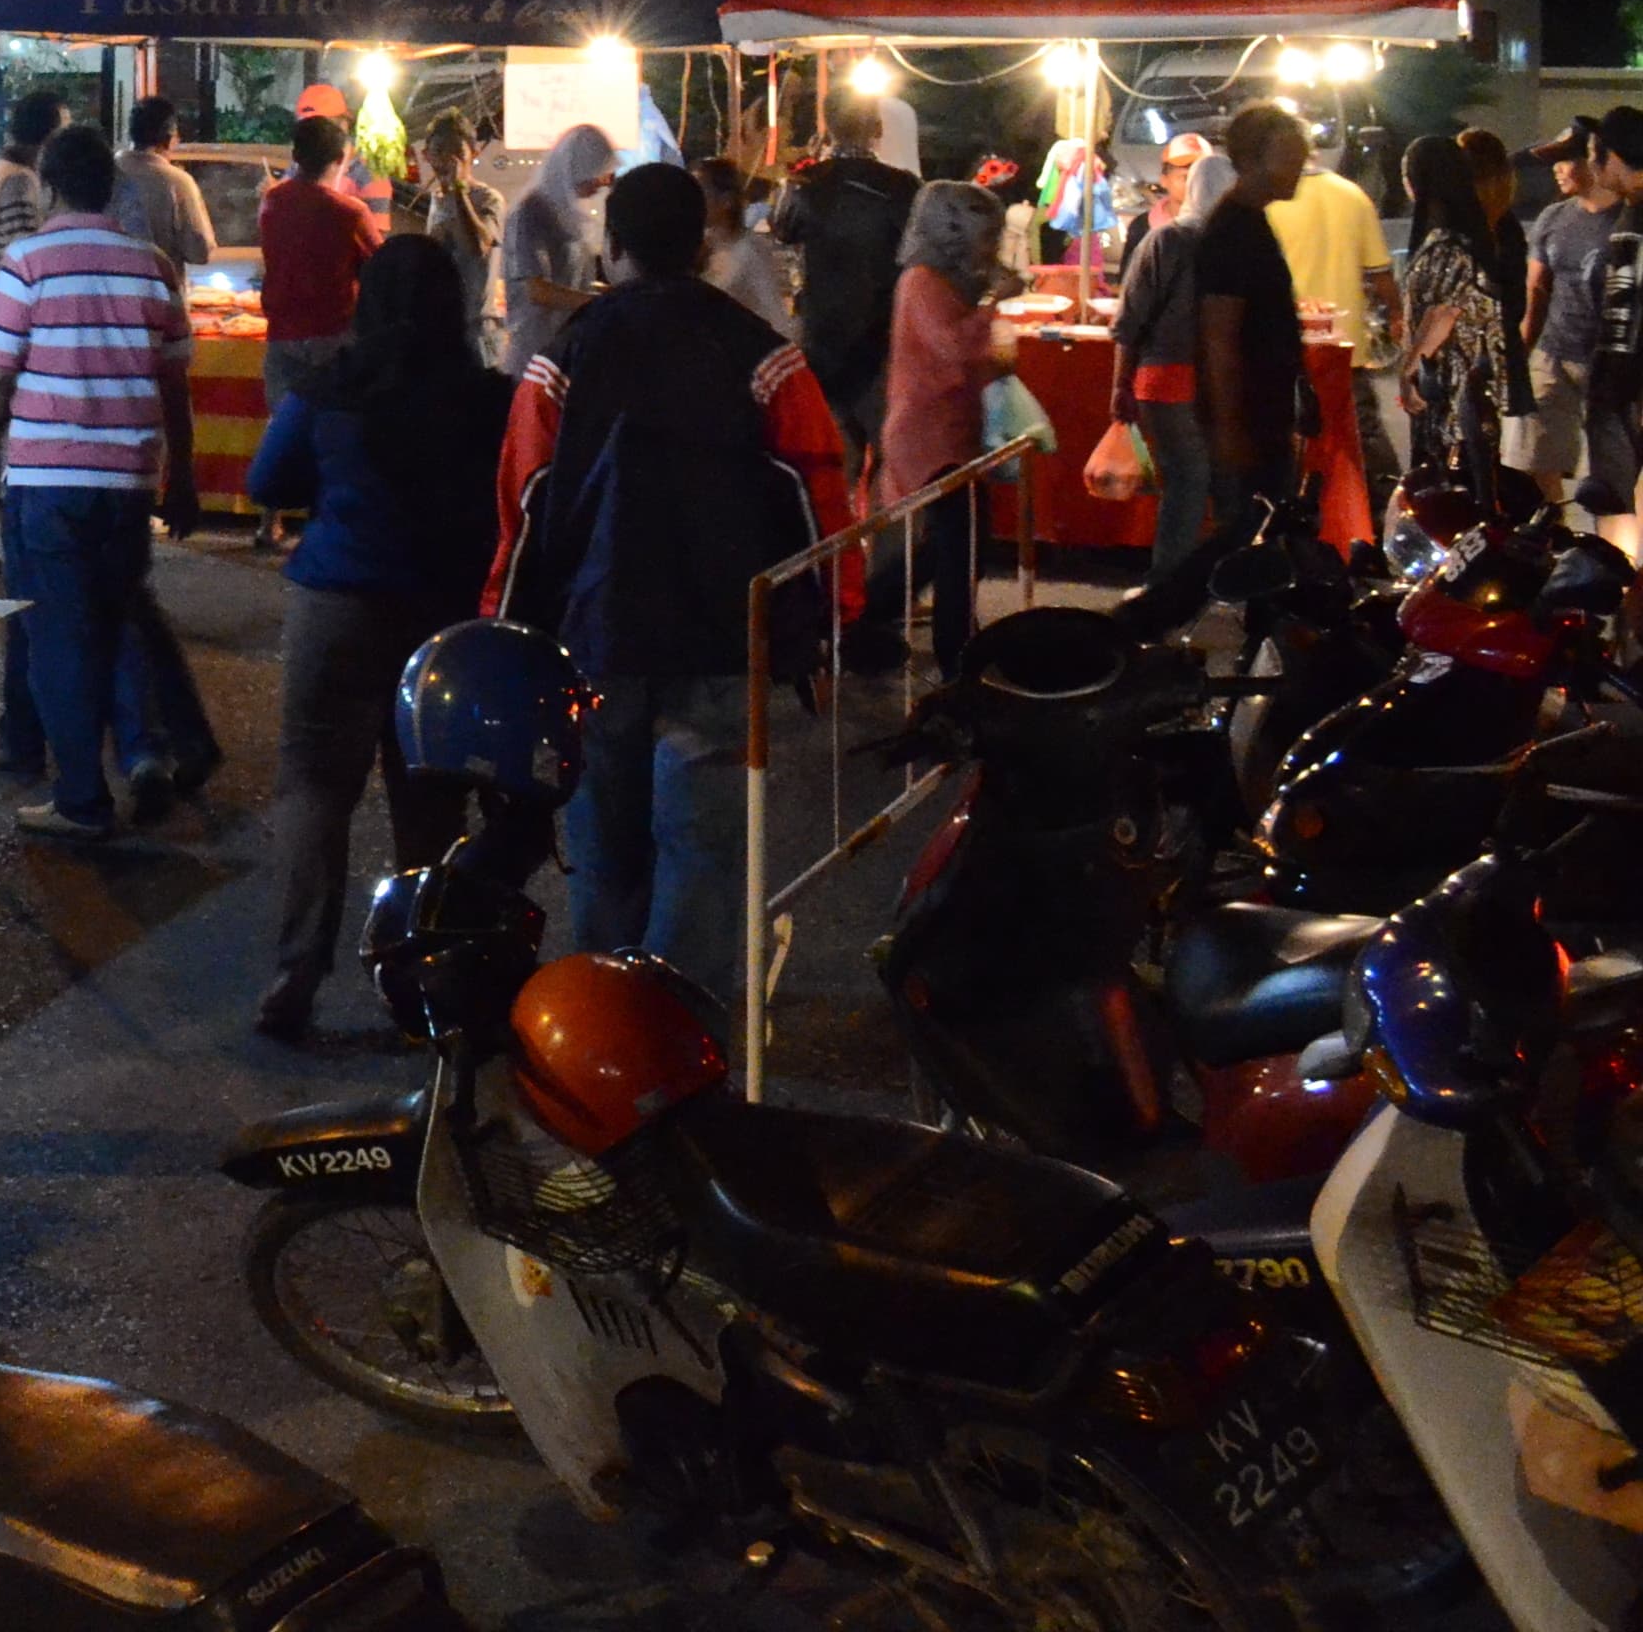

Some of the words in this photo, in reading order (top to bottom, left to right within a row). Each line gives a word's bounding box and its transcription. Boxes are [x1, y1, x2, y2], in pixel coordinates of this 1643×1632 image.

[276, 1146, 392, 1178] KV2249
[1204, 1399, 1261, 1463] KV
[1213, 1425, 1320, 1528] 2249
[246, 1547, 326, 1606] SUZUKI
